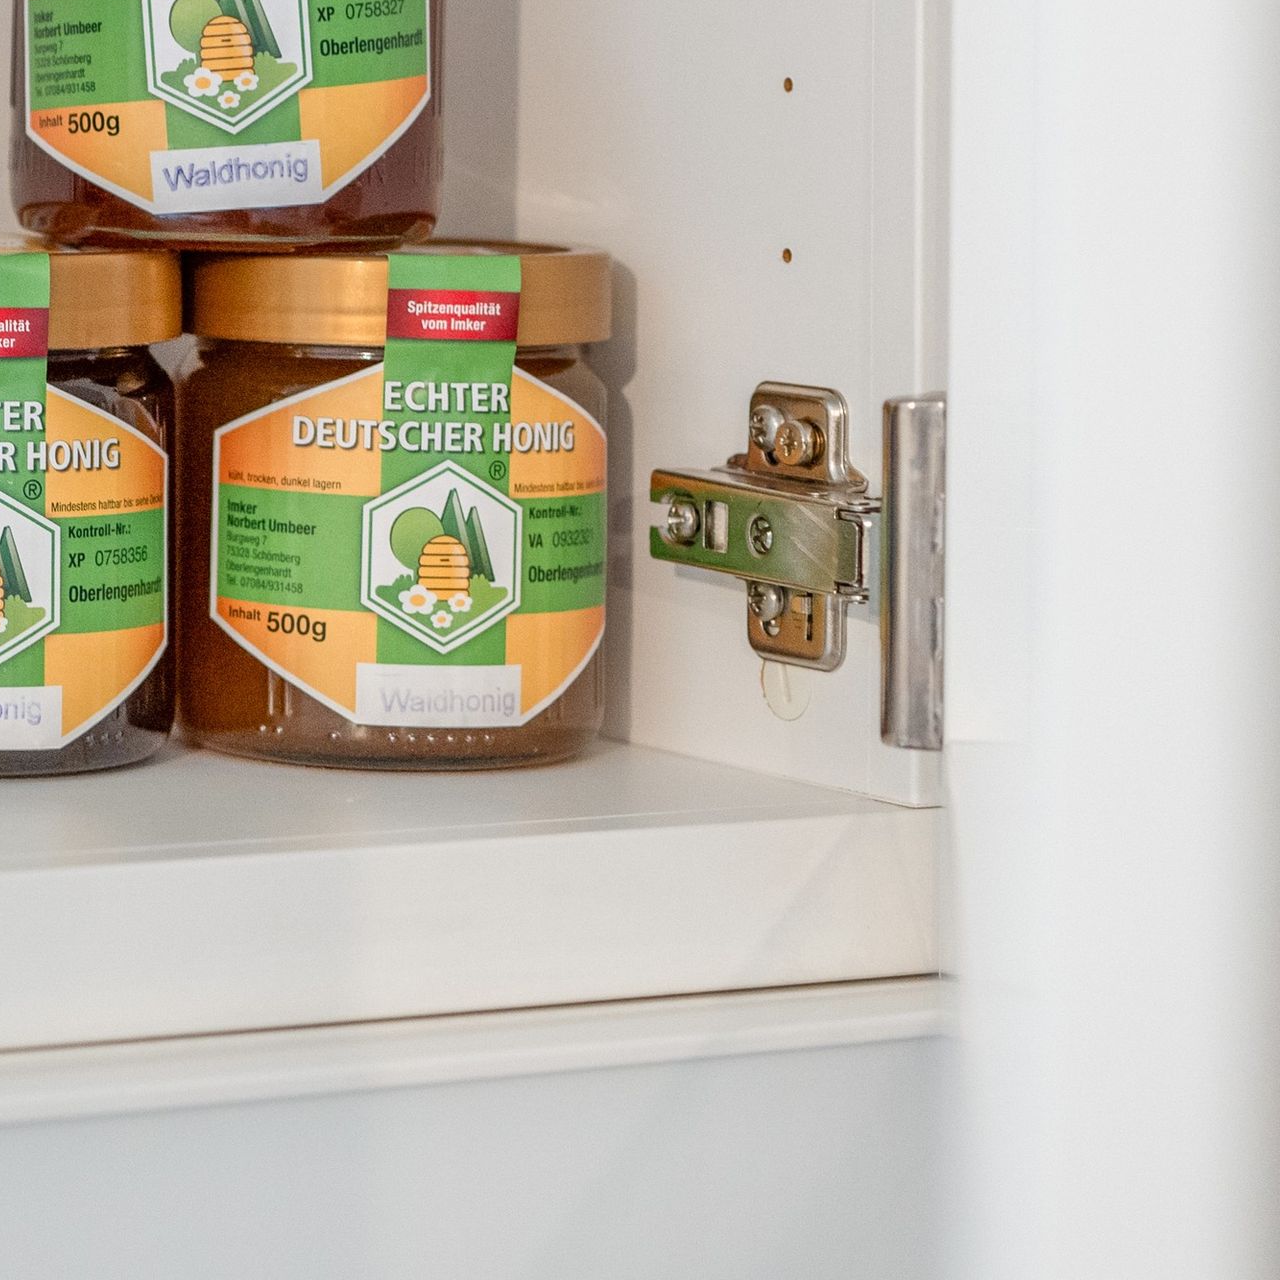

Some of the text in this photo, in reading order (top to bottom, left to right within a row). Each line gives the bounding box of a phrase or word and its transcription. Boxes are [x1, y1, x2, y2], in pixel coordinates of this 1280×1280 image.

[317, 6, 335, 22] XP
[64, 21, 102, 36] Umbeer
[320, 29, 423, 57] Oberlengenhardt
[39, 111, 120, 137] Inhalt 500g
[162, 152, 308, 192] Waldhonig
[407, 299, 501, 317] Spitzenqualität
[421, 317, 486, 332] vom Imker
[384, 380, 510, 413] ECHTER
[292, 415, 575, 453] DEUTSCHER HONIG
[27, 438, 121, 472] HONIG
[247, 472, 279, 486] trocken,
[281, 475, 311, 487] dunkel
[313, 478, 342, 491] lagern
[51, 500, 96, 512] Mindestens
[99, 499, 122, 510] haltbar
[227, 499, 257, 515] Imker
[68, 523, 131, 539] Kontroll-Nr.:
[227, 514, 316, 535] Norbert Umbeer
[262, 534, 268, 545] 7
[529, 533, 543, 548] VA
[68, 545, 148, 568] XP 0758356
[252, 548, 301, 566] Schömberg
[69, 576, 162, 603] Oberlengenhardt
[229, 605, 327, 642] Inhalt 500g
[381, 686, 516, 717] Waldhonig
